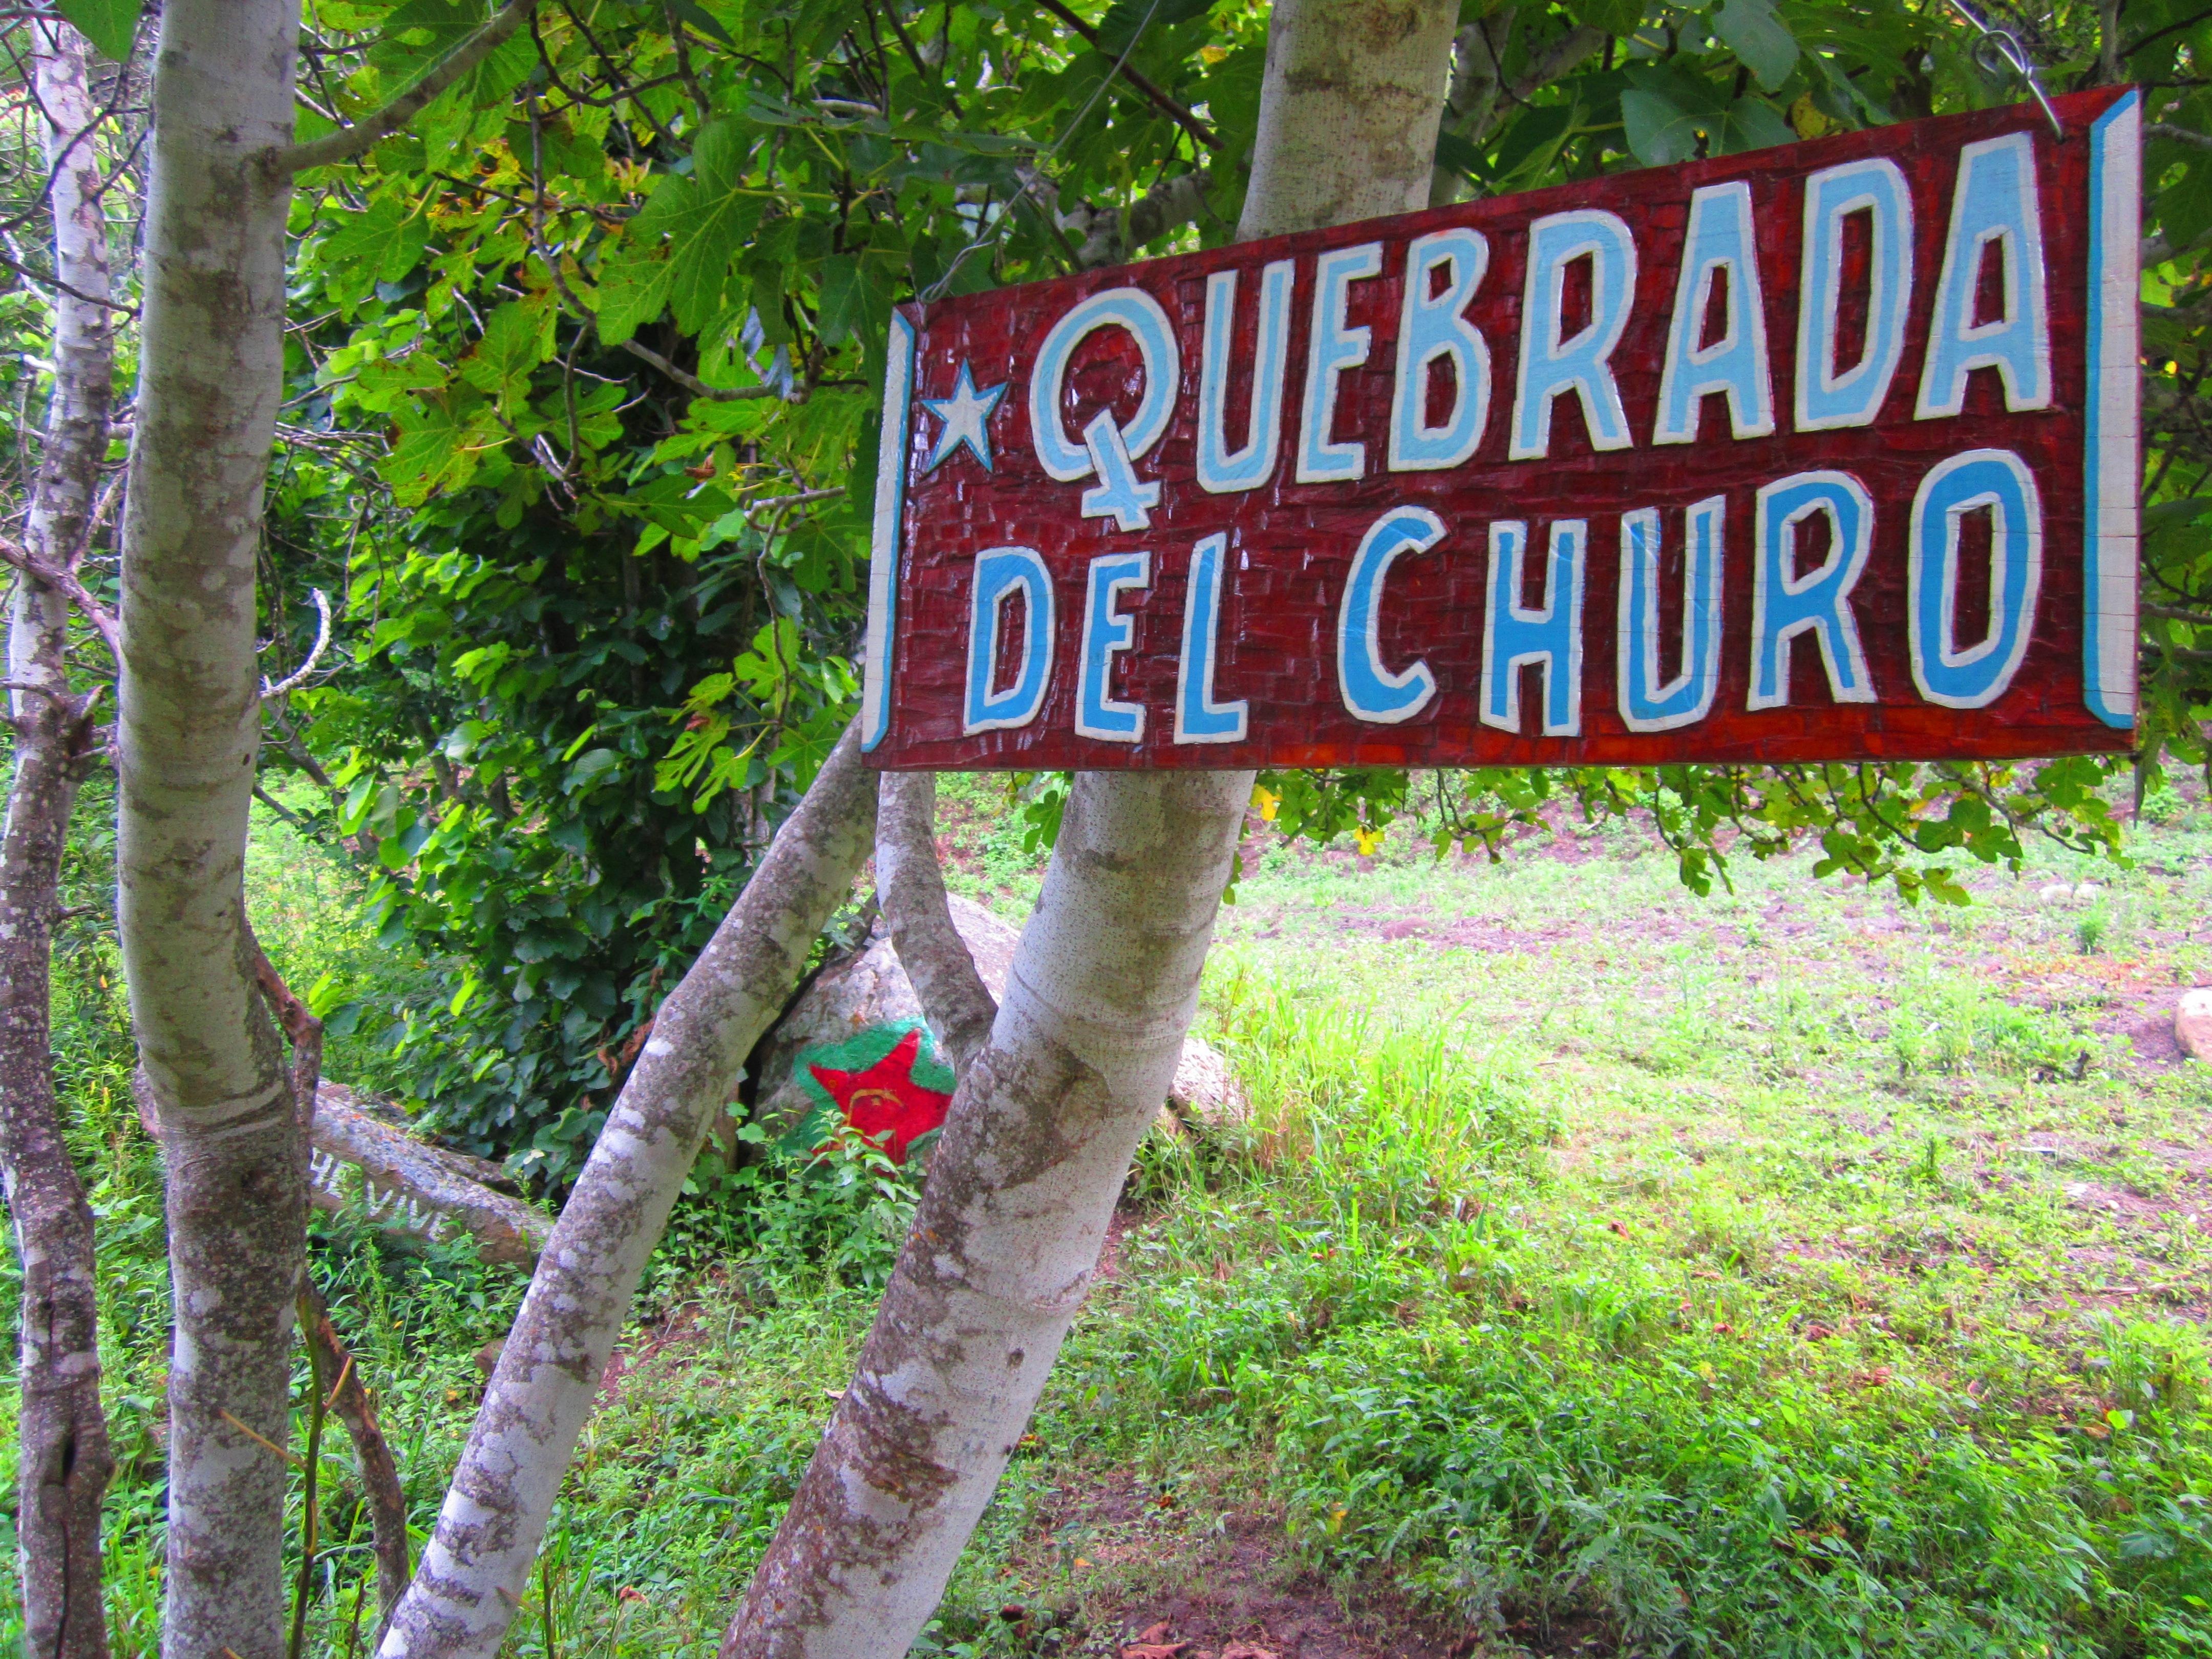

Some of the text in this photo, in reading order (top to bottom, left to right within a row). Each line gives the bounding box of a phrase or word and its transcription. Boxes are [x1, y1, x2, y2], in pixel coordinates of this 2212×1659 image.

[1028, 131, 2051, 531] QUEBRADA
[962, 448, 2043, 746] DEL CHURO
